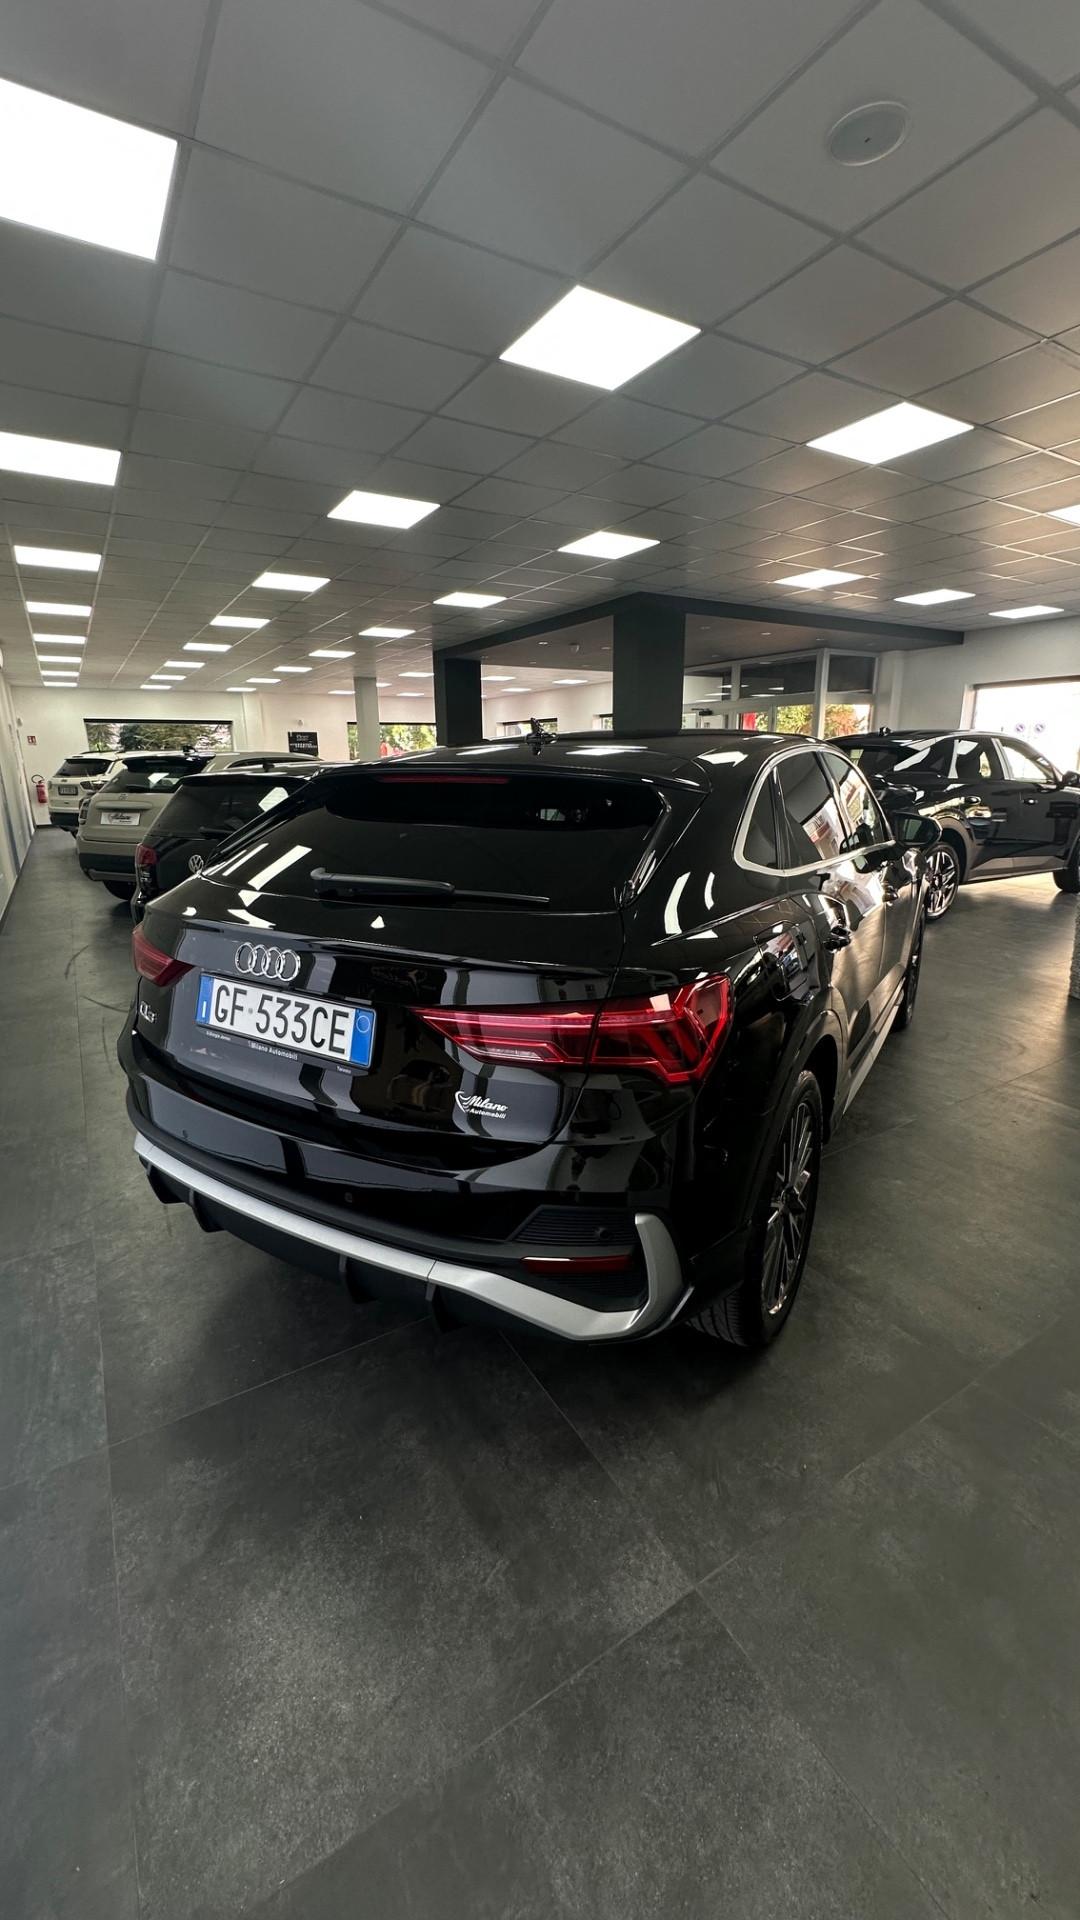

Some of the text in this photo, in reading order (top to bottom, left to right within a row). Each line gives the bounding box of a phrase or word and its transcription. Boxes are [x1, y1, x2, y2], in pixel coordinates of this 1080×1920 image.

[214, 984, 350, 1055] GF 533CE
[268, 1047, 298, 1061] Automobili
[468, 1095, 508, 1112] Milano
[469, 1108, 507, 1119] Automobili
